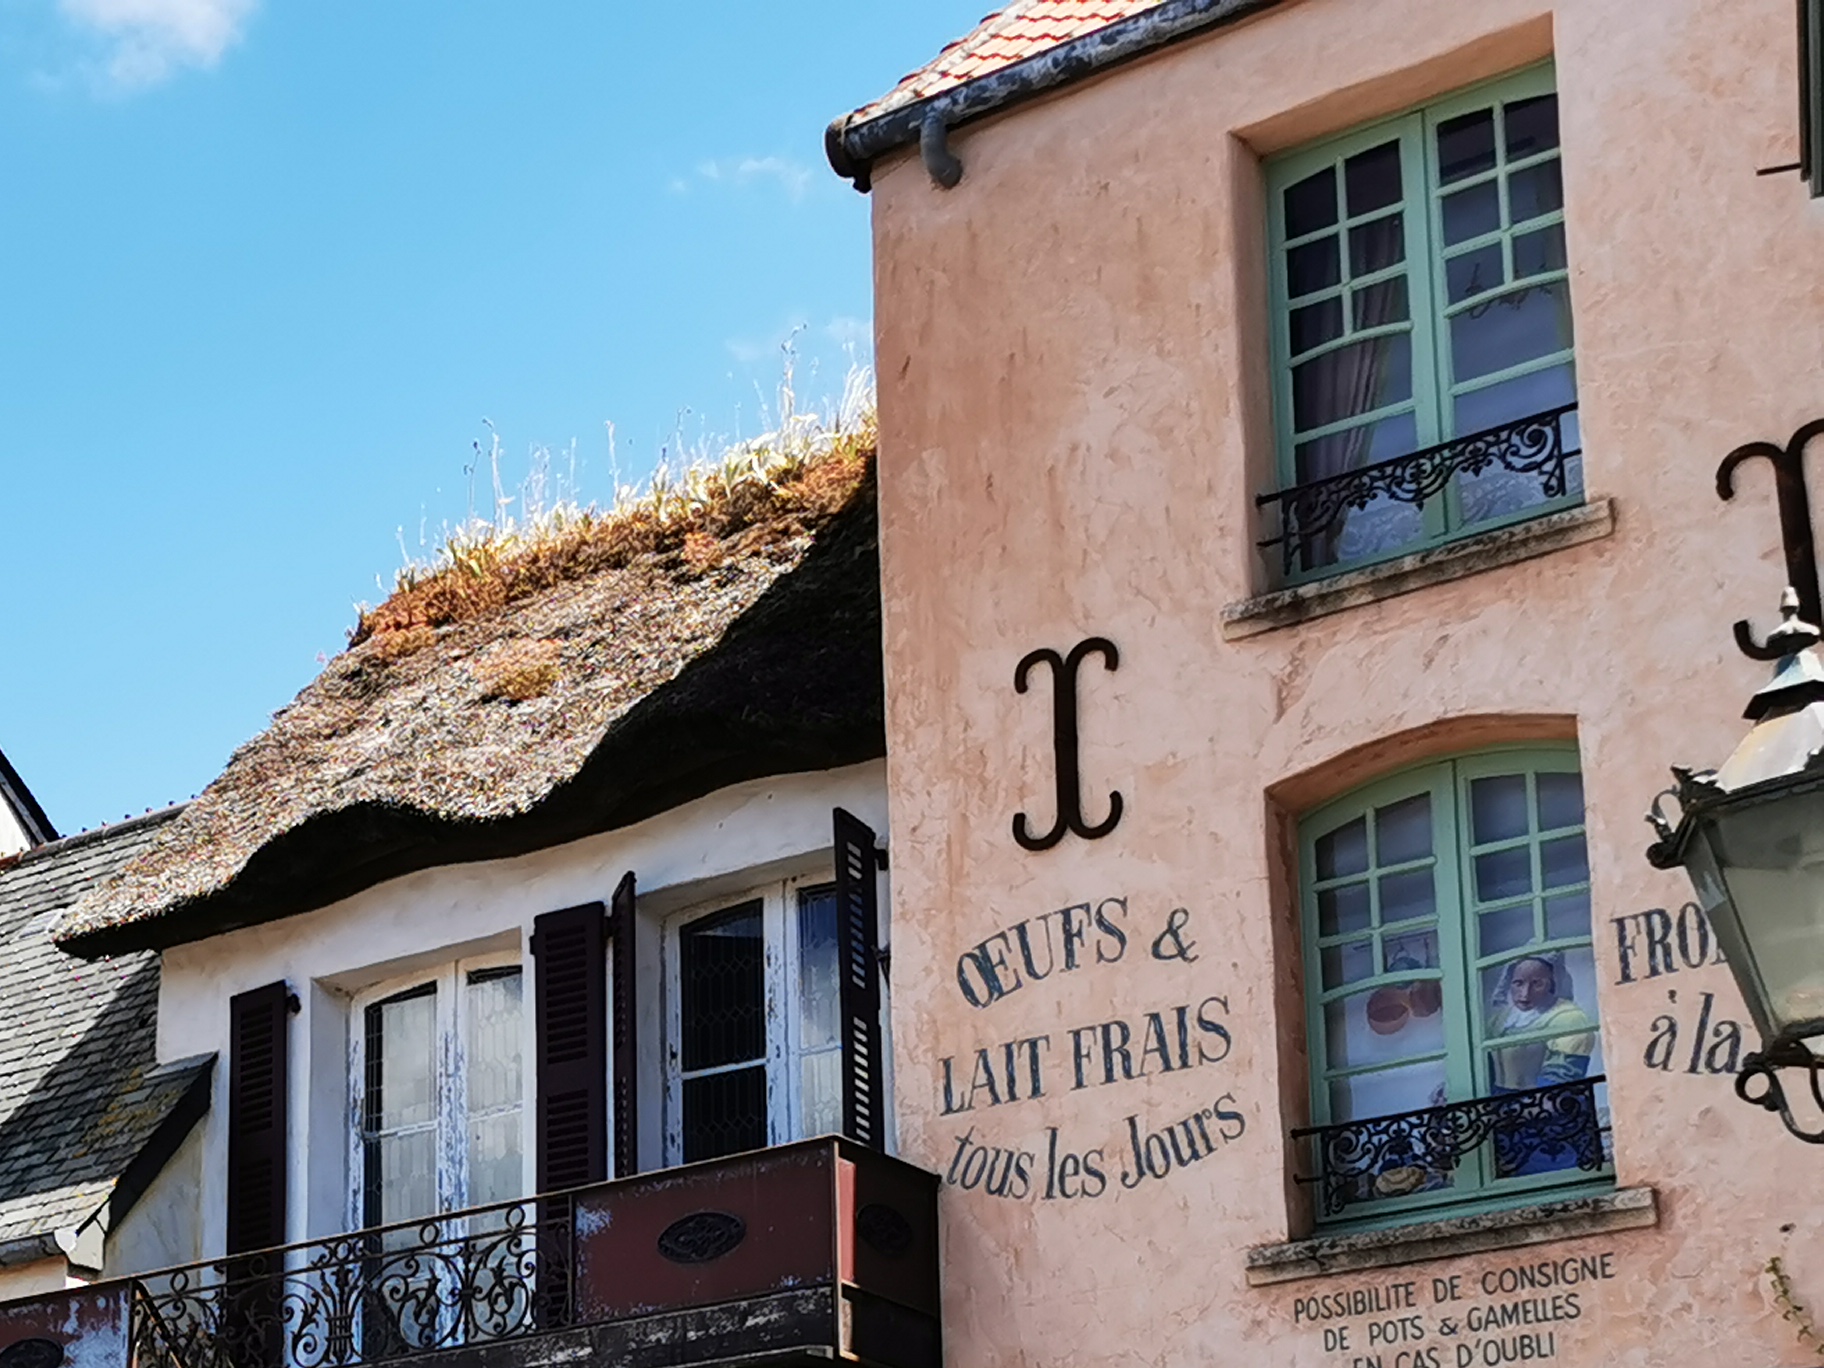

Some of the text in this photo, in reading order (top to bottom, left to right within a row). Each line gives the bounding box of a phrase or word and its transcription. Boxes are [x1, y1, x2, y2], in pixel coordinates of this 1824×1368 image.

[955, 895, 1200, 1009] ŒUFS &
[937, 995, 1232, 1117] LAIT FRAIS
[1643, 989, 1742, 1076] à la
[946, 1124, 1036, 1200] tous
[1040, 1126, 1107, 1200] les
[1293, 1252, 1616, 1324] POSSIBILITE DE CONSIGNE
[1323, 1292, 1582, 1353] DE POTS & GAMELLES
